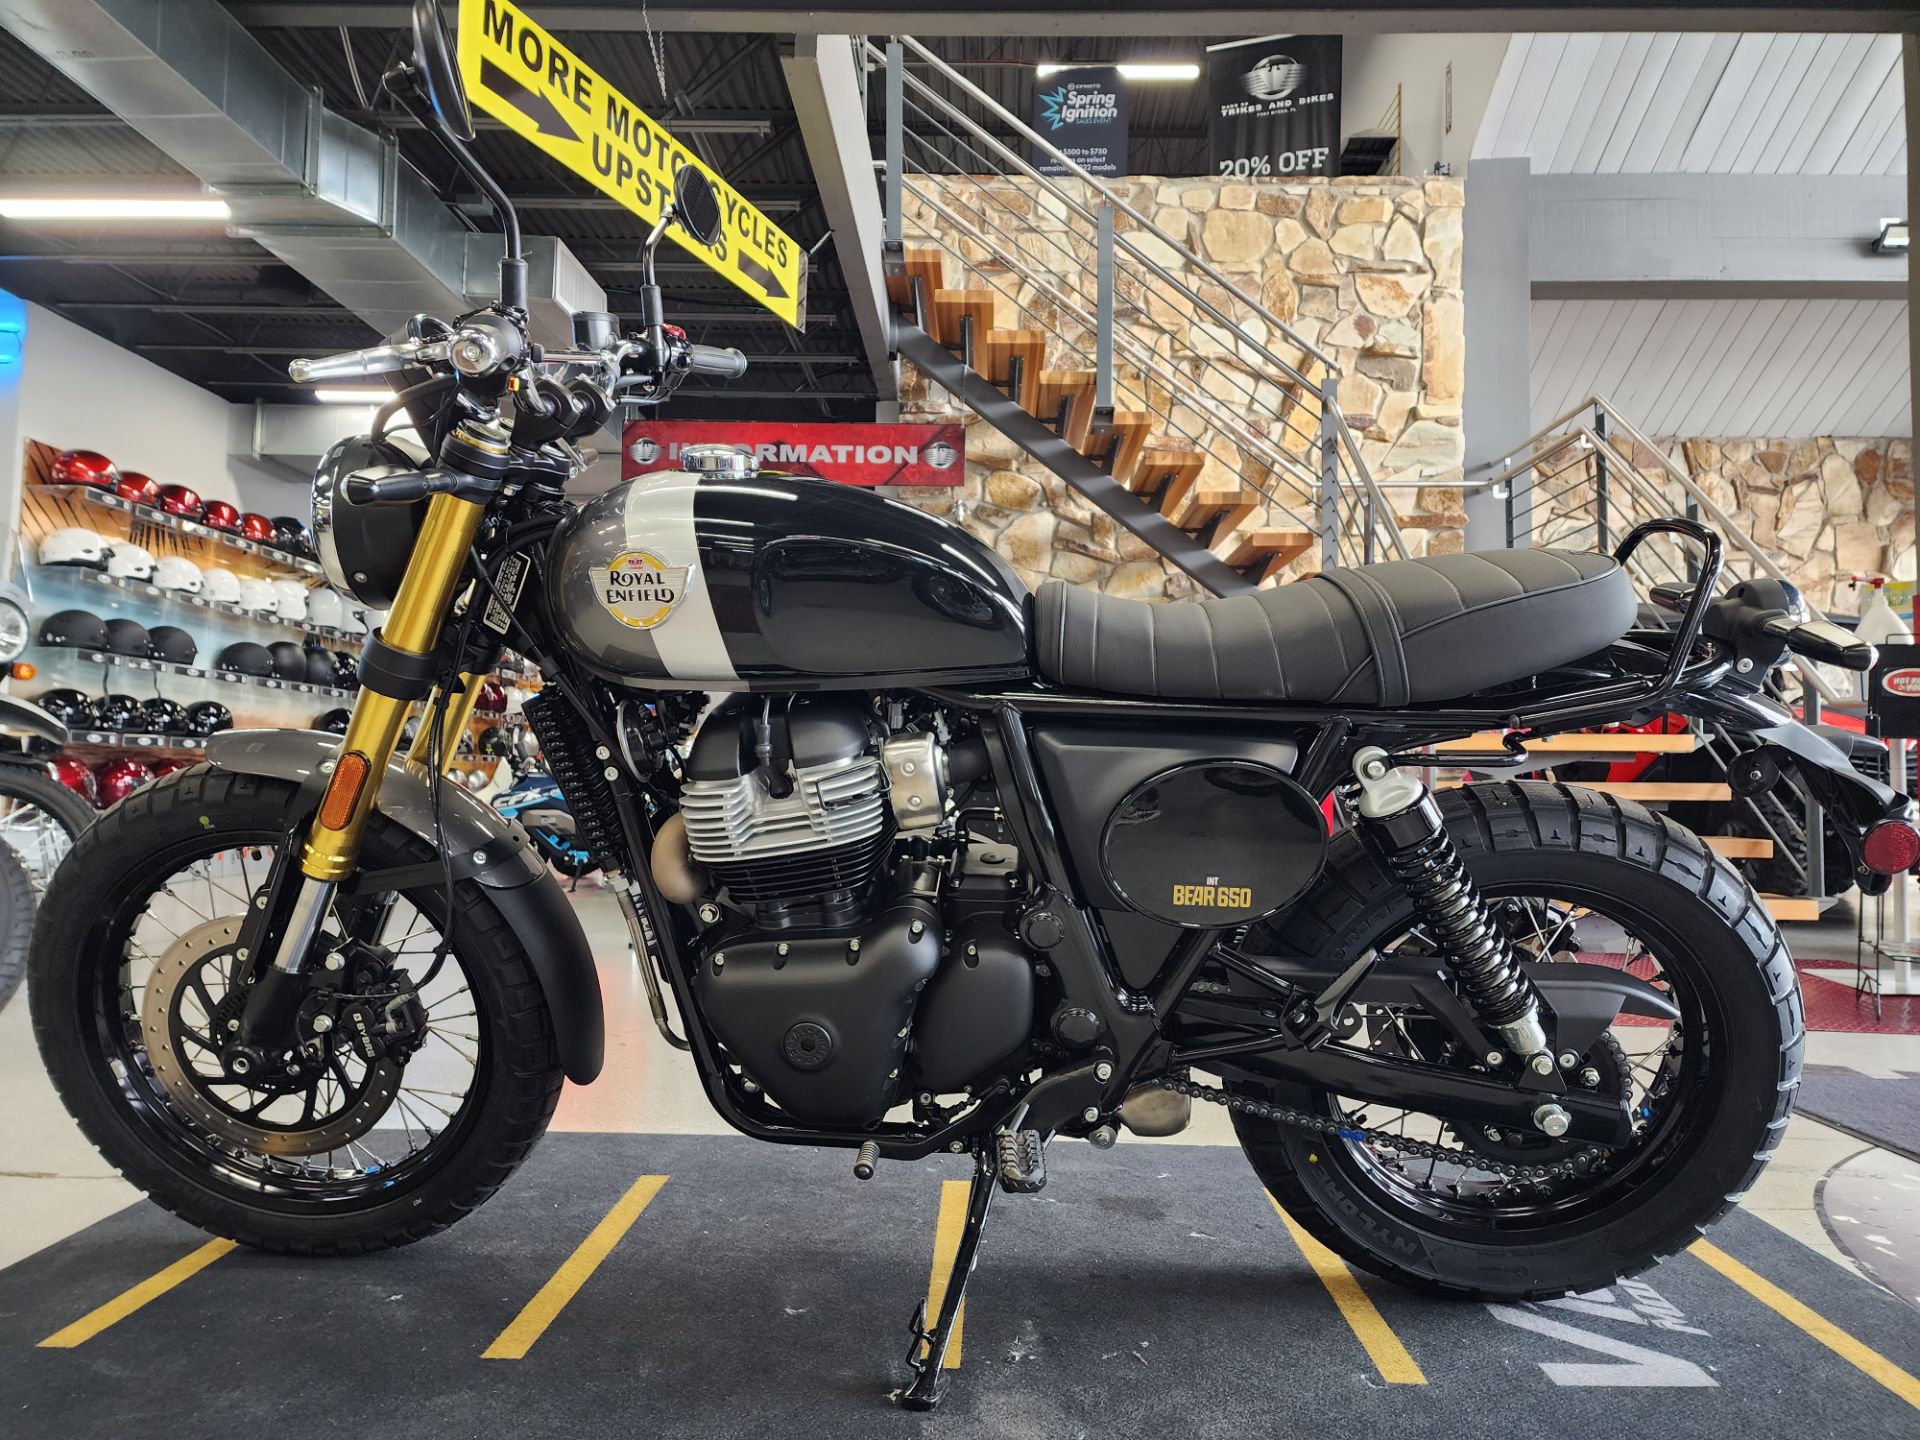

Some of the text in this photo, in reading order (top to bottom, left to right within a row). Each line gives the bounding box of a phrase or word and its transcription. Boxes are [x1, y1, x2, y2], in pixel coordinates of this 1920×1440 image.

[1067, 91, 1116, 108] Spring
[1221, 104, 1262, 117] TRIKES
[1269, 100, 1292, 110] AND
[1299, 93, 1334, 105] BIKES
[1062, 105, 1118, 123] Ignition
[483, 3, 788, 269] MORE MOTOYCLES
[1219, 147, 1329, 177] 20% OFF
[592, 132, 728, 262] UPSTS
[669, 442, 918, 464] IRMATION
[610, 571, 665, 587] ROYAL
[606, 588, 675, 604] ENFIELD
[1173, 885, 1252, 907] BEAR 650
[356, 1022, 376, 1058] BYBRE
